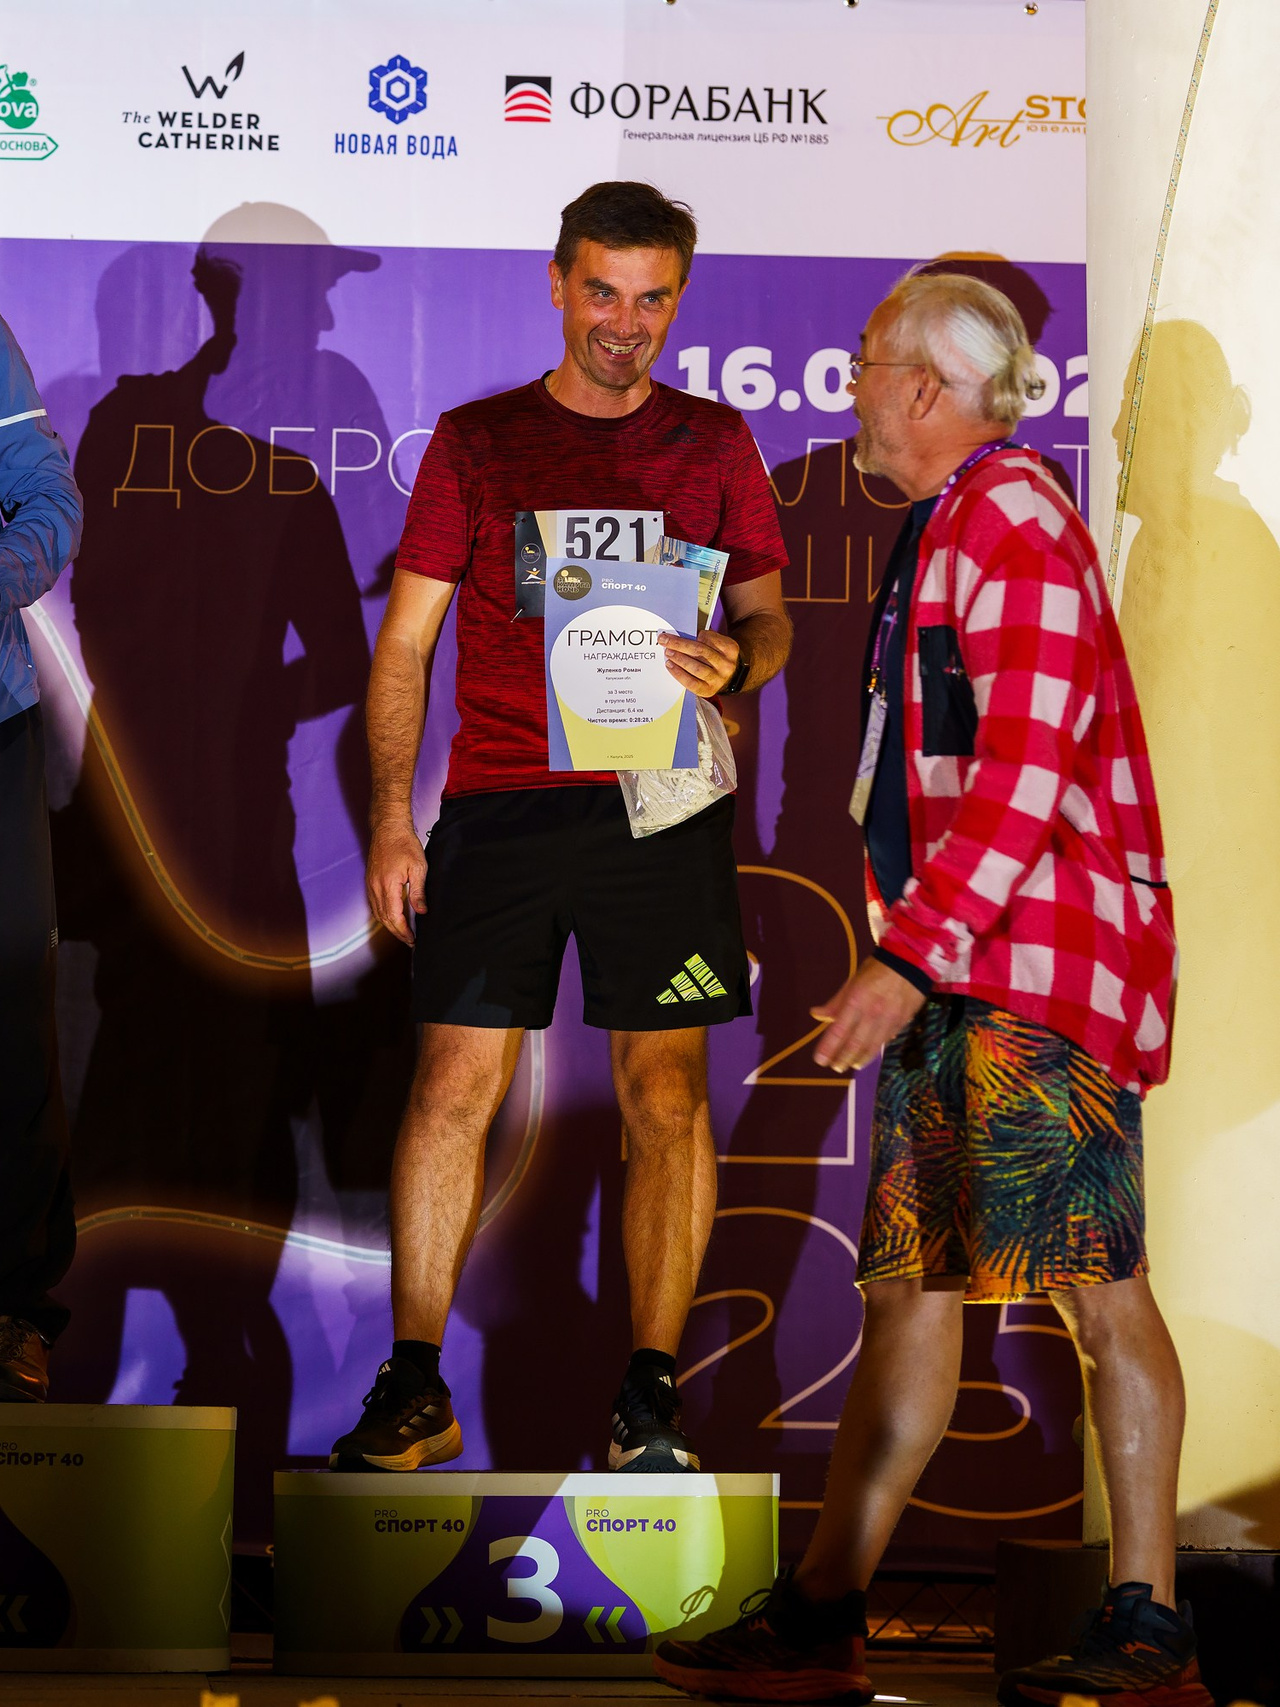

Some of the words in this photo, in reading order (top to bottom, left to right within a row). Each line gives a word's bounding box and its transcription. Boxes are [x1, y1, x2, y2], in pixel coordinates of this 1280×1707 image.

[570, 82, 828, 125] ФОРАБАНК
[1025, 95, 1086, 119] ST
[122, 111, 151, 124] The
[157, 111, 260, 130] WELDER
[138, 132, 280, 151] CATHERINE
[623, 129, 694, 143] Генеральная
[697, 132, 751, 144] лицензия
[753, 132, 769, 145] ЦБ
[772, 133, 788, 144] РФ
[0, 140, 48, 151] ОСНОВА
[334, 133, 397, 155] НОВАЯ
[407, 135, 458, 160] ВОДА
[565, 516, 645, 562] 521
[601, 582, 633, 591] СПОРТ
[567, 629, 663, 647] ГРАМОТ
[583, 652, 656, 661] НАГРАЖДАЕТСЯ
[60, 1452, 84, 1467] 40
[374, 1509, 398, 1518] PRO
[586, 1509, 610, 1518] PRO
[374, 1519, 438, 1533] СПОРТ
[441, 1519, 465, 1533] 40
[586, 1518, 650, 1533] СПОРТ
[652, 1518, 677, 1533] 40
[486, 1536, 565, 1643] 3
